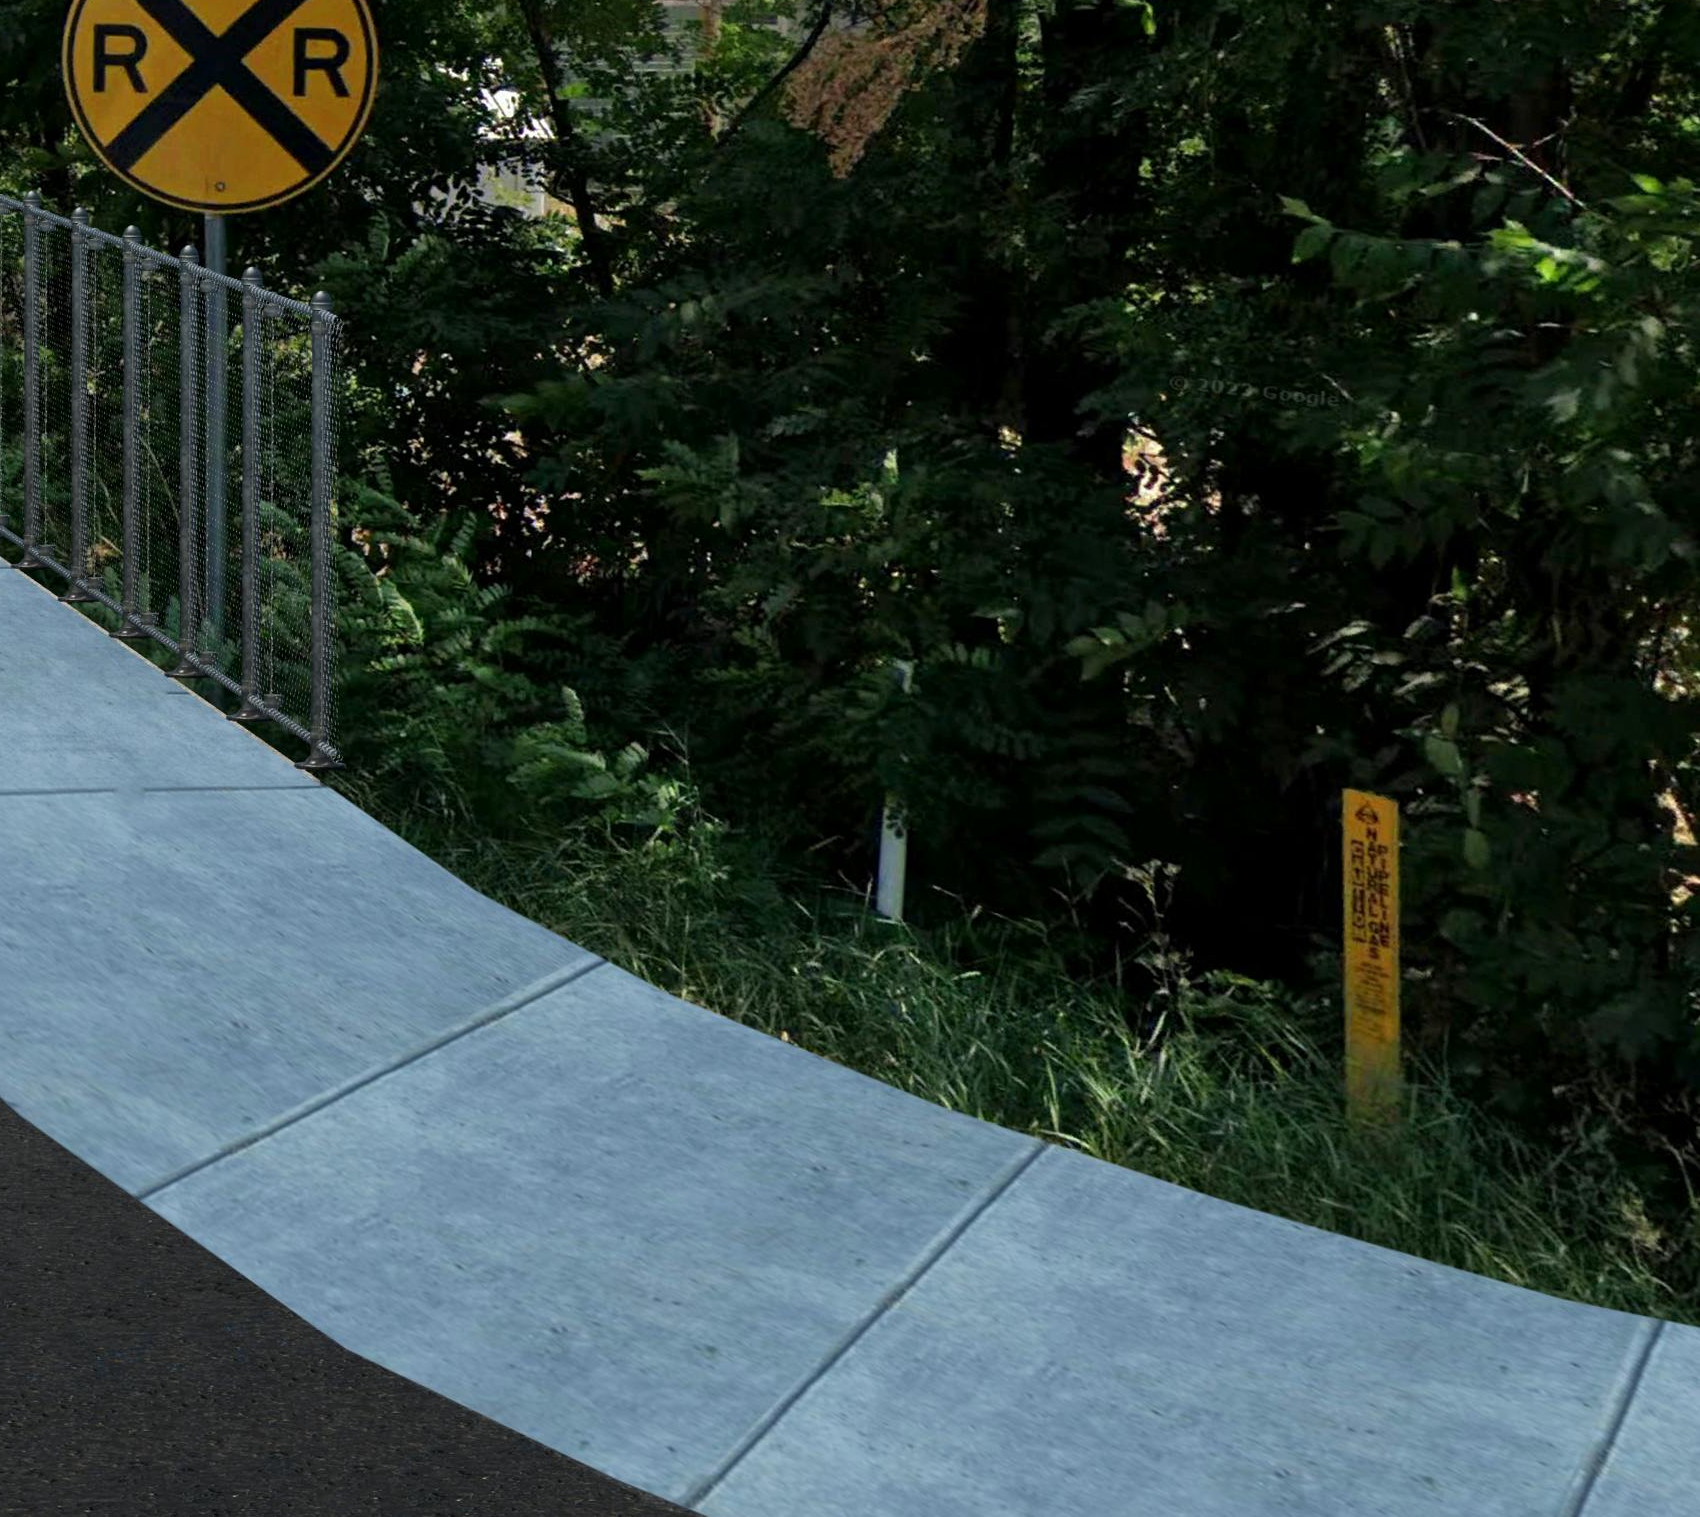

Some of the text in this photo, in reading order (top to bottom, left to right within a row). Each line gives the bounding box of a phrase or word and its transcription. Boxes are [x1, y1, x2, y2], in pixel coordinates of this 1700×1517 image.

[93, 24, 350, 97] R R
[1366, 826, 1380, 959] NATURAL GAS
[1377, 844, 1390, 948] PIPELINE
